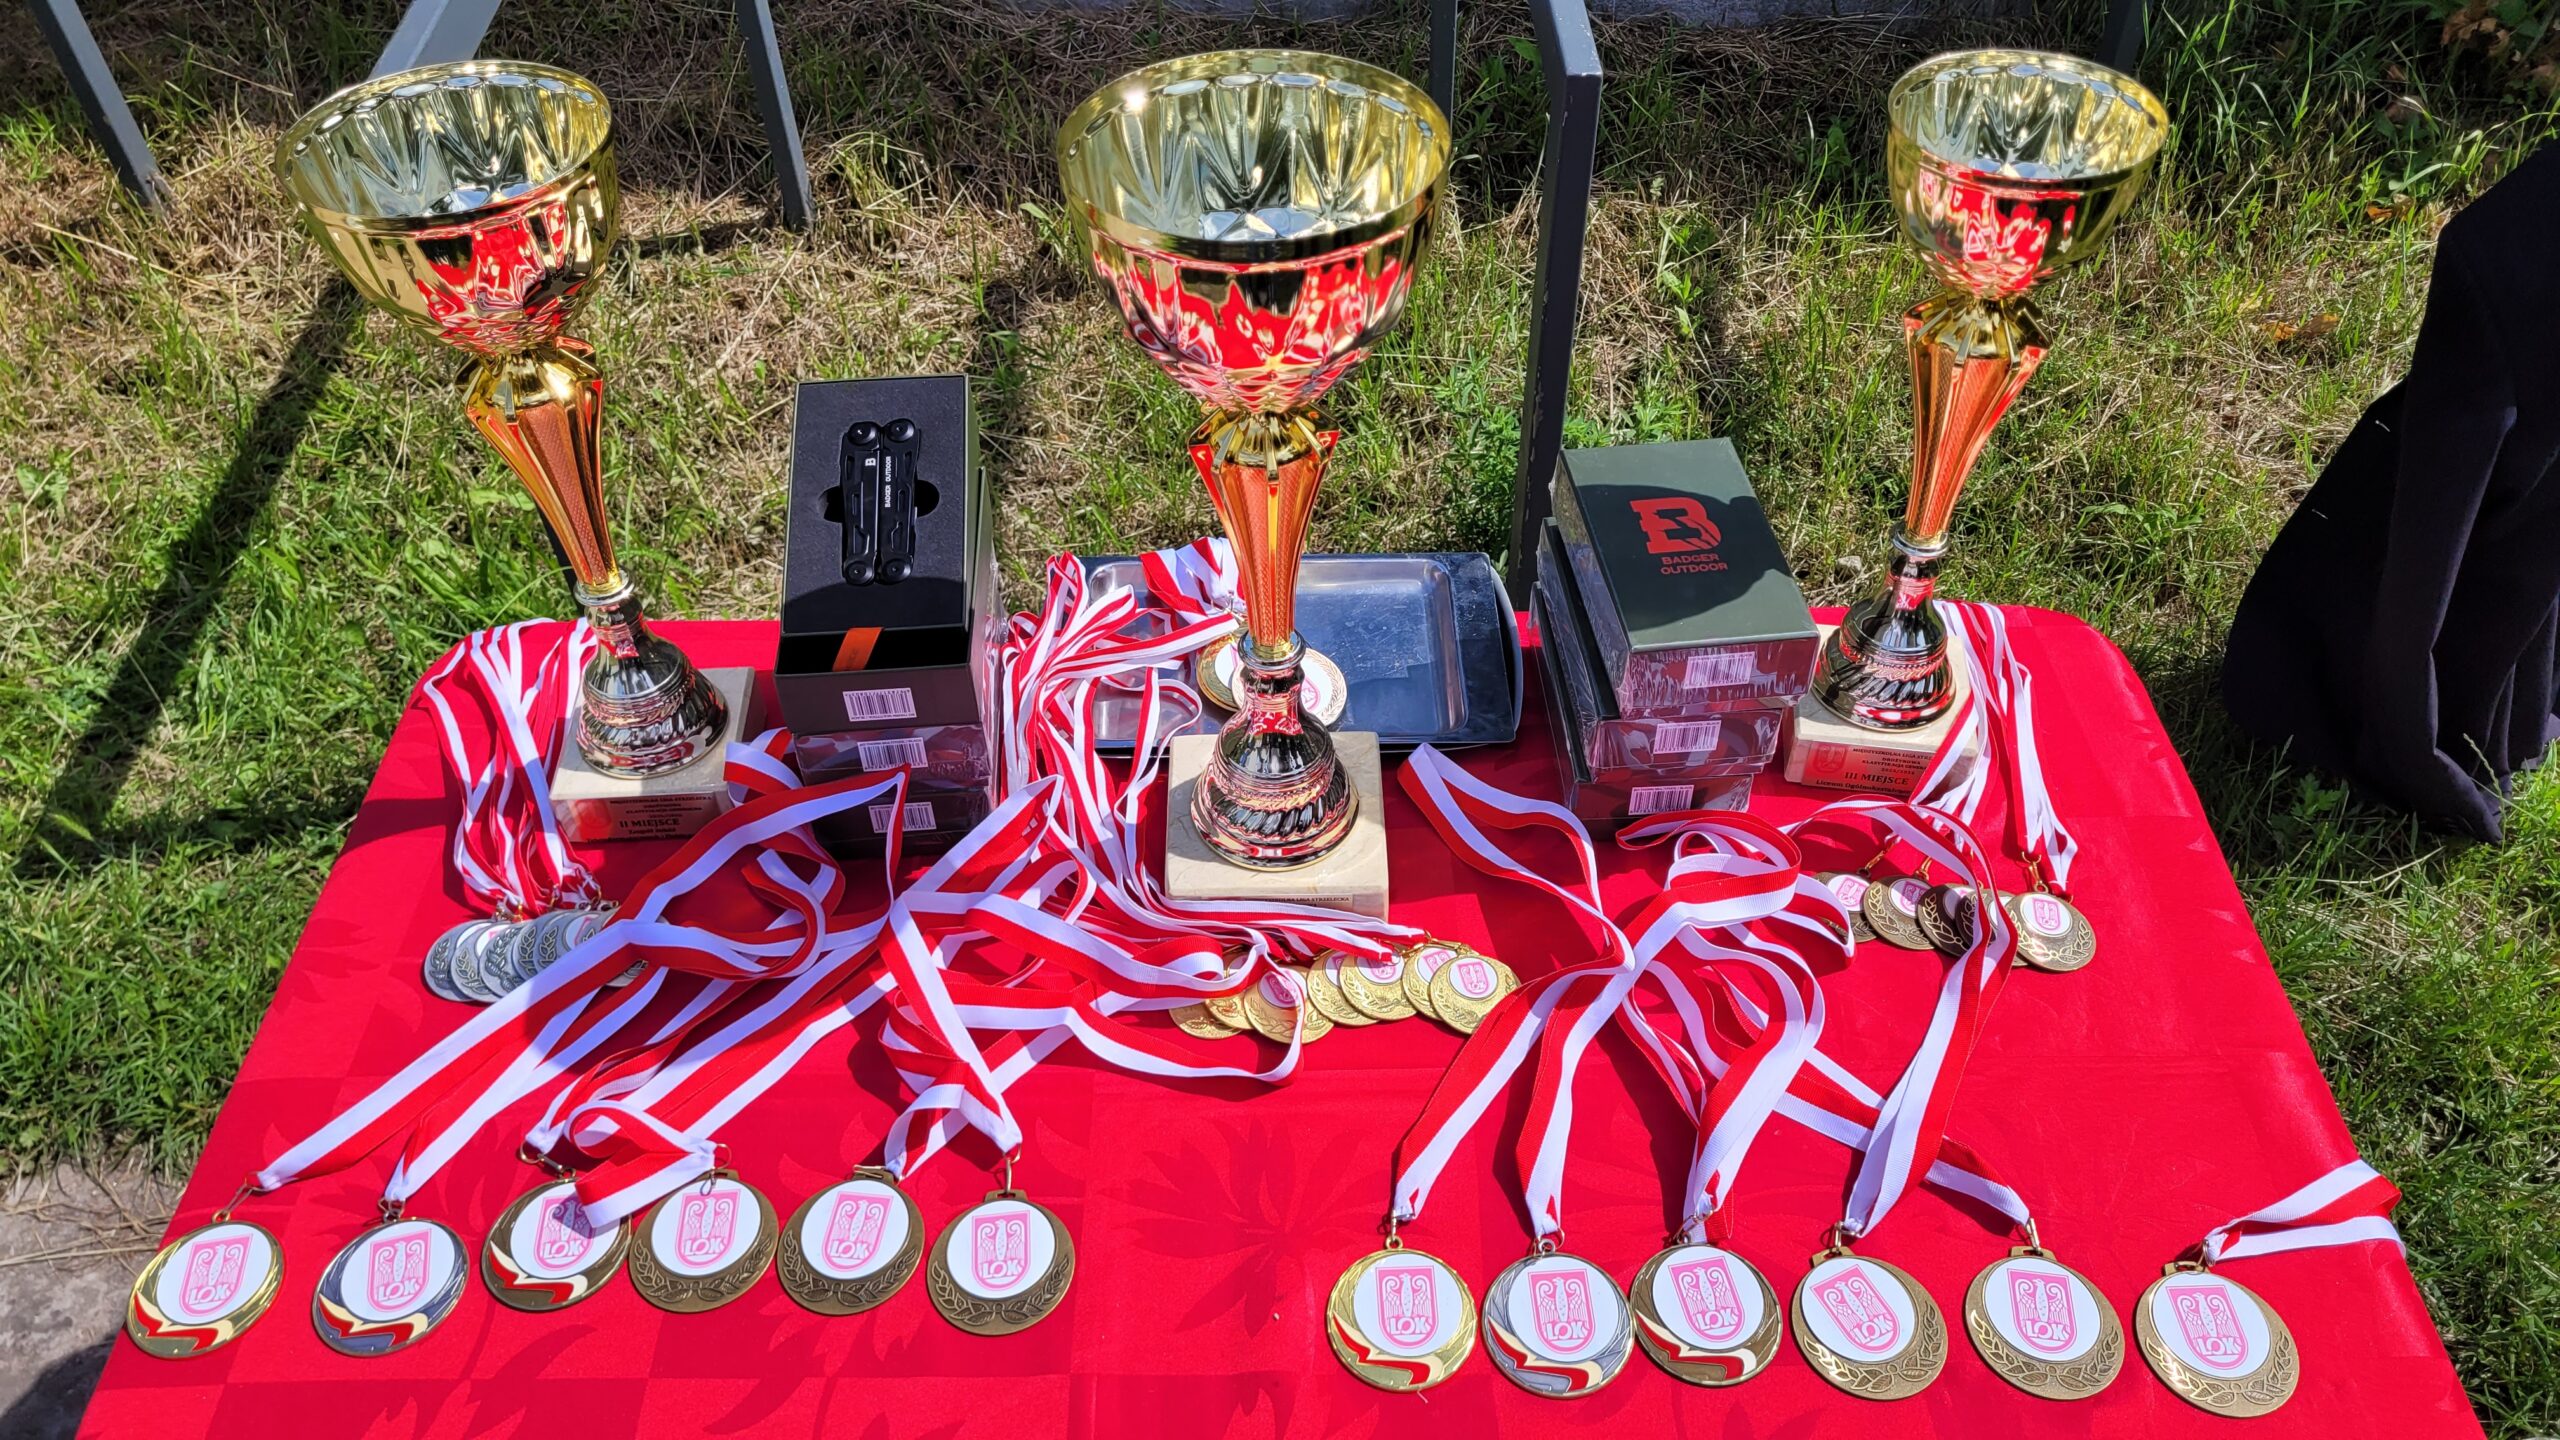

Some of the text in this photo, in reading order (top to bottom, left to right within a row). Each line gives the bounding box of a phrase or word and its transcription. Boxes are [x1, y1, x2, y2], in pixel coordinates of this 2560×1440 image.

[1660, 562, 1728, 575] OUTDOOR
[1661, 553, 1719, 565] BADGER
[1844, 771, 1910, 786] III MIEJSCE
[619, 818, 681, 829] II MIEJSCE
[543, 1240, 585, 1259] LOK
[685, 1237, 726, 1256] LOK
[830, 1239, 871, 1259] LOK
[982, 1259, 1024, 1279] LOK
[189, 1283, 232, 1304] LOK
[377, 1278, 420, 1301] LOK
[1389, 1317, 1432, 1335] LOK
[1694, 1308, 1738, 1330] LOK
[1545, 1321, 1589, 1340] LOK
[1852, 1314, 1893, 1344] LOK
[2025, 1320, 2069, 1341] LOK
[2196, 1337, 2242, 1356] LOK
